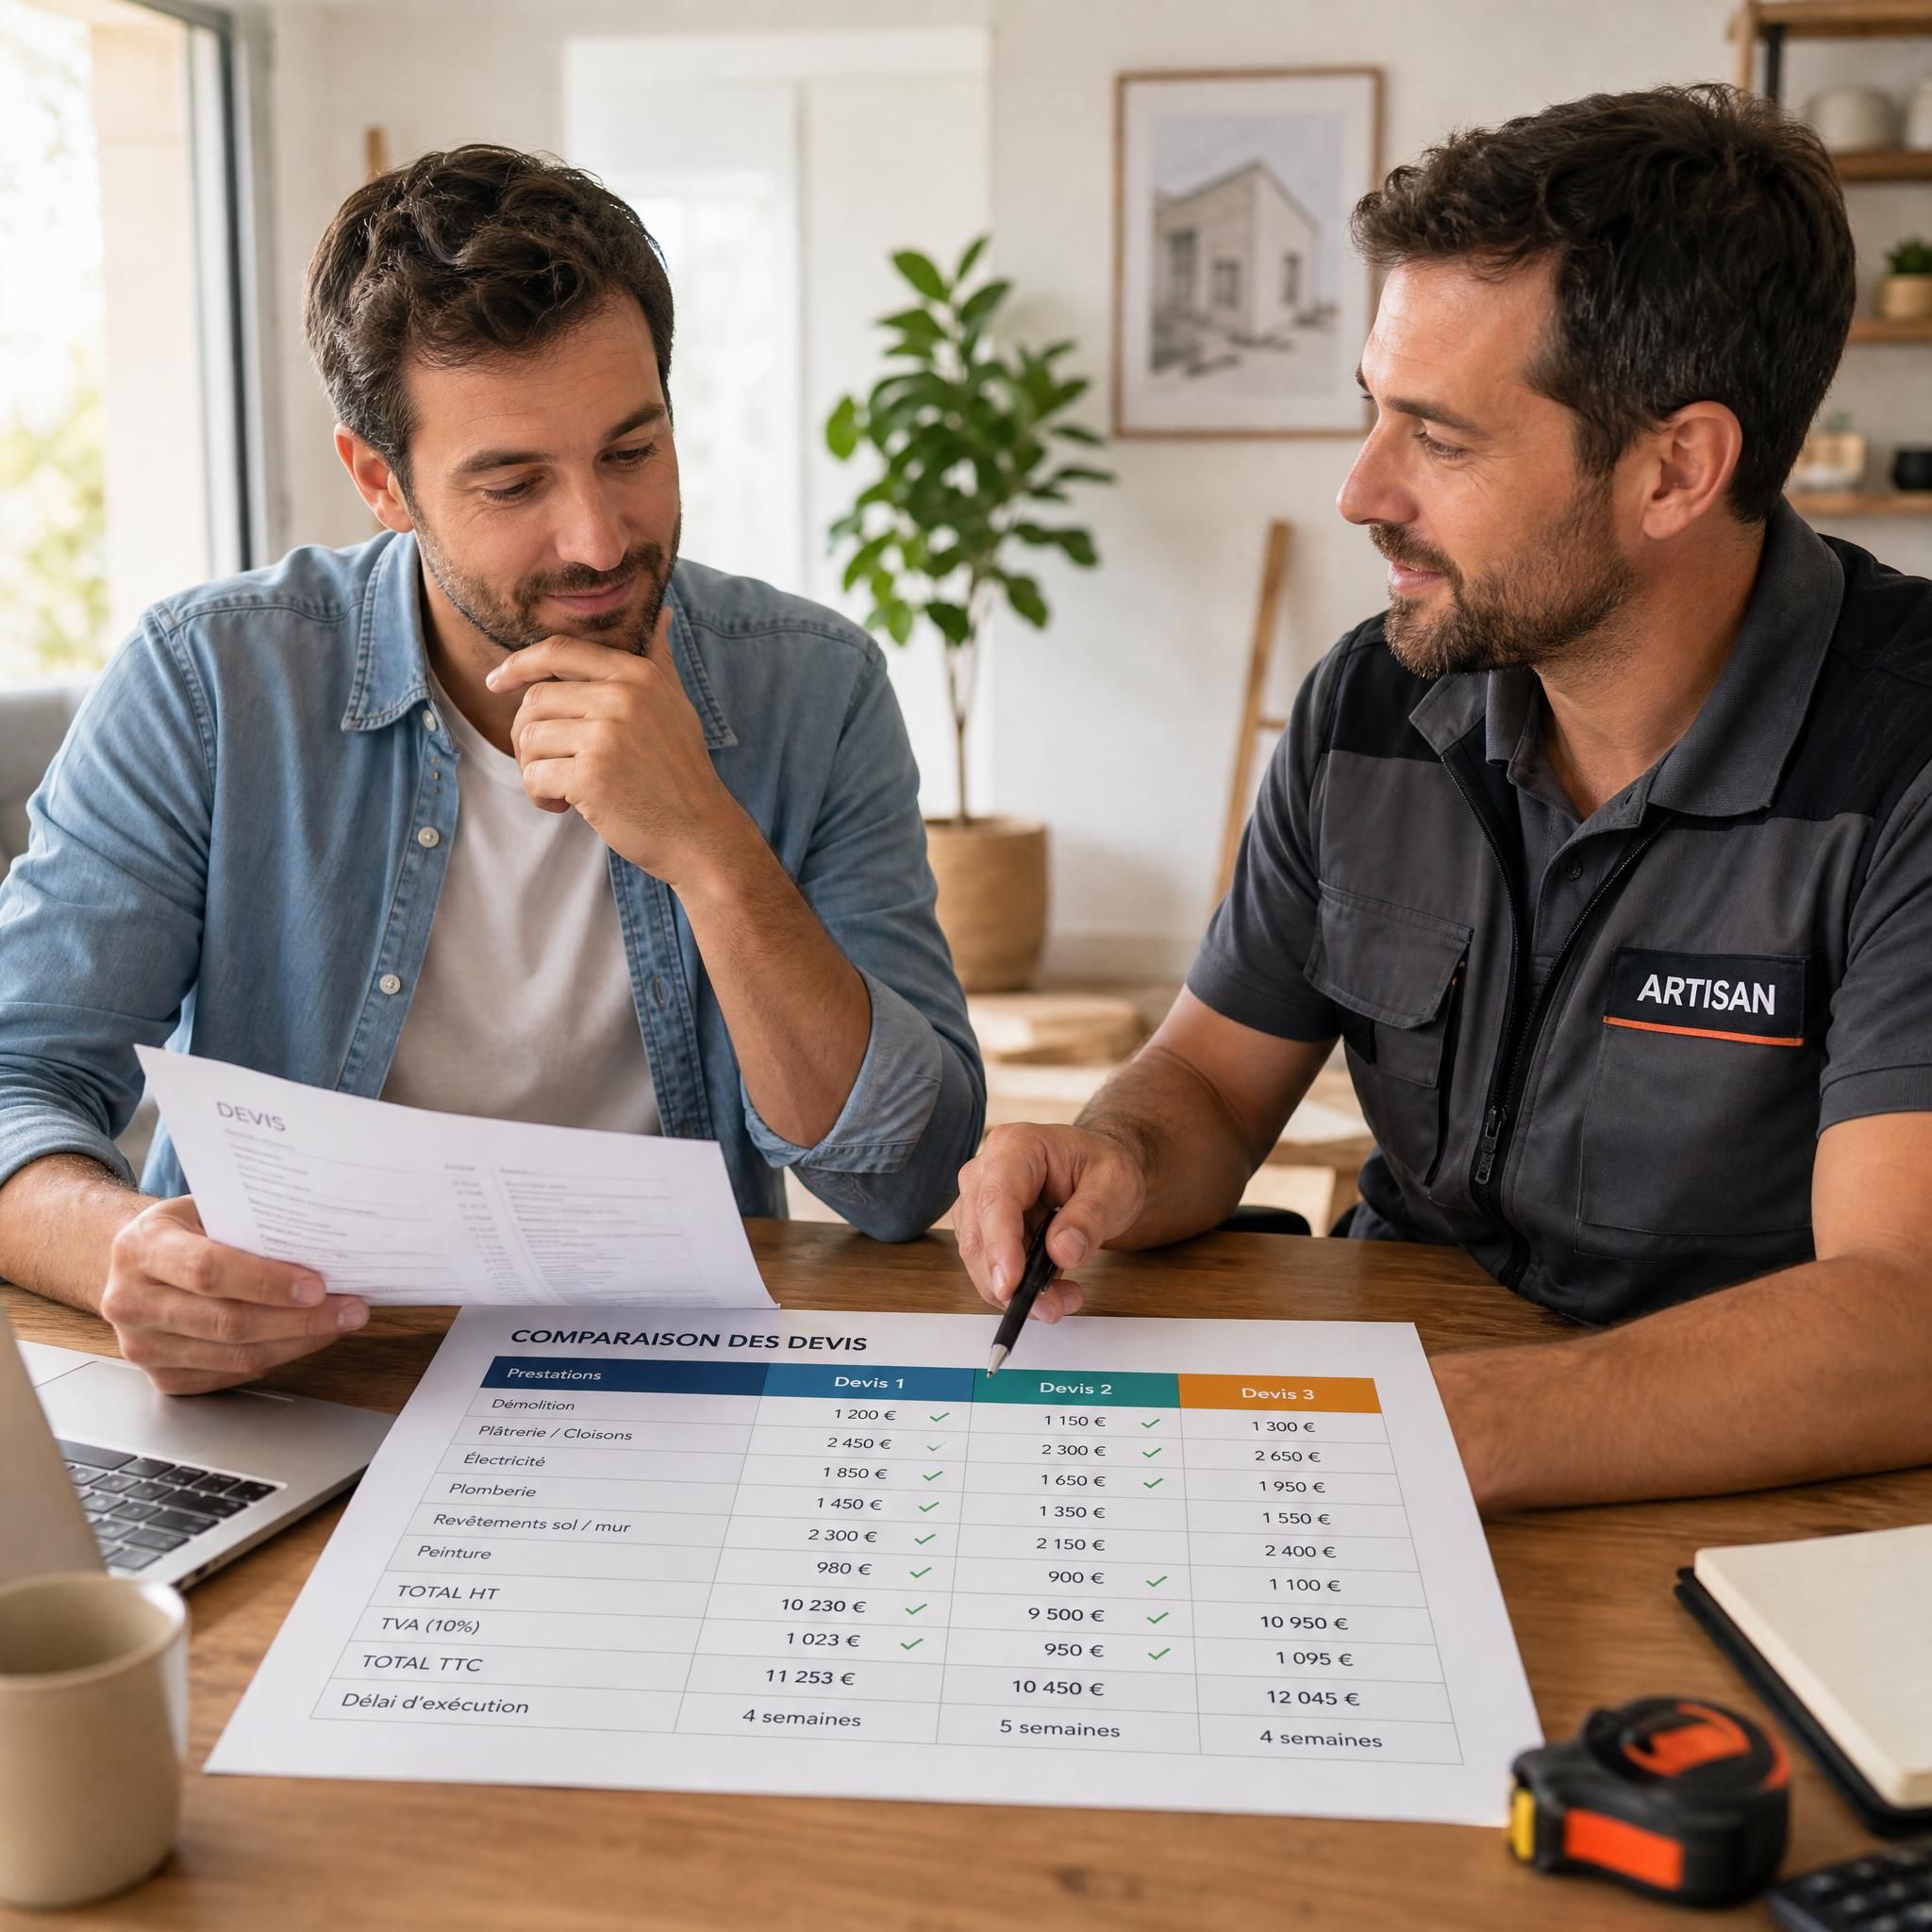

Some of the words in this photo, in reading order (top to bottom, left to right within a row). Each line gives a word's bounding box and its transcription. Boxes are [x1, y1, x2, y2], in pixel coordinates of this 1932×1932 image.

[1637, 974, 1775, 1016] ARTISAN
[217, 1101, 286, 1132] DEVIS
[510, 1329, 721, 1348] COMPARAISON
[727, 1334, 780, 1349] DES
[787, 1335, 868, 1352] DEVIS
[507, 1367, 602, 1381] Prestations
[834, 1375, 889, 1389] Devis
[895, 1377, 905, 1390] 1
[1040, 1382, 1095, 1395] Devis
[1100, 1383, 1112, 1395] 2
[1241, 1388, 1297, 1400] Devis
[1302, 1389, 1315, 1400] 3
[491, 1398, 575, 1411] Démolition
[835, 1408, 841, 1419] 1
[846, 1408, 879, 1421] 200
[882, 1409, 897, 1422] €
[1044, 1414, 1051, 1425] 1
[1058, 1415, 1089, 1427] 150
[1093, 1416, 1107, 1427] €
[478, 1425, 547, 1438] Plâtrerie
[549, 1427, 561, 1439] /
[563, 1427, 633, 1441] Cloisons
[1252, 1421, 1259, 1432] 1
[1266, 1421, 1298, 1433] 300
[1302, 1422, 1316, 1433] €
[826, 1437, 839, 1448] 2
[841, 1437, 874, 1449] 450
[878, 1439, 892, 1450] €
[1041, 1443, 1052, 1456] 2
[1057, 1444, 1089, 1457] 300
[1093, 1445, 1107, 1457] €
[463, 1451, 546, 1467] Électricité
[1254, 1450, 1266, 1461] 2
[1270, 1450, 1303, 1463] 650
[1307, 1451, 1322, 1463] €
[823, 1466, 830, 1478] 1
[837, 1467, 870, 1479] 850
[874, 1468, 888, 1480] €
[1041, 1474, 1048, 1486] 1
[1055, 1474, 1088, 1487] 650
[1092, 1475, 1107, 1488] €
[1258, 1480, 1267, 1492] 1
[1273, 1480, 1307, 1493] 950
[1311, 1481, 1326, 1494] €
[448, 1483, 537, 1498] Plomberie
[817, 1497, 824, 1508] 1
[829, 1497, 864, 1510] 450
[869, 1499, 883, 1511] €
[1039, 1505, 1046, 1517] 1
[1054, 1506, 1088, 1519] 350
[1091, 1507, 1106, 1519] €
[1262, 1511, 1271, 1524] 1
[1278, 1512, 1312, 1525] 550
[1316, 1513, 1331, 1525] €
[433, 1513, 548, 1530] Revêtements
[551, 1518, 578, 1531] sol
[580, 1519, 592, 1532] /
[594, 1524, 632, 1533] mur
[808, 1528, 820, 1541] 2
[824, 1529, 859, 1542] 300
[863, 1530, 878, 1543] €
[417, 1544, 491, 1560] Peinture
[1036, 1537, 1047, 1550] 2
[1054, 1538, 1087, 1551] 150
[1091, 1539, 1106, 1552] €
[1264, 1544, 1276, 1557] 2
[1281, 1545, 1317, 1558] 400
[1322, 1546, 1337, 1559] €
[816, 1561, 852, 1575] 980
[857, 1563, 873, 1576] €
[1048, 1570, 1085, 1584] 900
[1090, 1572, 1105, 1585] €
[1269, 1578, 1277, 1591] 1
[1286, 1578, 1322, 1592] 100
[1326, 1579, 1341, 1592] €
[398, 1584, 462, 1599] TOTAL
[469, 1587, 501, 1600] HT
[781, 1598, 804, 1611] 10
[808, 1599, 846, 1613] 230
[851, 1600, 867, 1614] €
[1027, 1607, 1041, 1620] 9
[1046, 1607, 1084, 1622] 500
[1090, 1609, 1105, 1623] €
[382, 1617, 419, 1631] TVA
[425, 1618, 480, 1636] (10%)
[1259, 1615, 1284, 1629] 10
[1289, 1616, 1327, 1630] 950
[1333, 1617, 1349, 1631] €
[787, 1632, 794, 1645] 1
[802, 1632, 840, 1647] 023
[844, 1634, 861, 1648] €
[1043, 1642, 1083, 1657] 950
[1089, 1644, 1105, 1658] €
[363, 1654, 430, 1671] TOTAL
[440, 1657, 484, 1673] TTC
[1275, 1651, 1285, 1665] 1
[1292, 1651, 1332, 1666] 095
[1338, 1653, 1354, 1667] €
[766, 1669, 787, 1683] 11
[794, 1670, 834, 1685] 253
[839, 1672, 856, 1686] €
[1012, 1679, 1037, 1693] 10
[1041, 1680, 1083, 1695] 450
[1089, 1682, 1105, 1697] €
[341, 1692, 398, 1708] Délai
[1267, 1690, 1291, 1705] 12
[1297, 1690, 1338, 1706] 045
[1343, 1692, 1360, 1707] €
[741, 1708, 756, 1723] 4
[761, 1711, 861, 1727] semaines
[999, 1719, 1012, 1734] 5
[1019, 1722, 1121, 1738] semaines
[1259, 1729, 1274, 1744] 4
[1280, 1732, 1383, 1748] semaines
